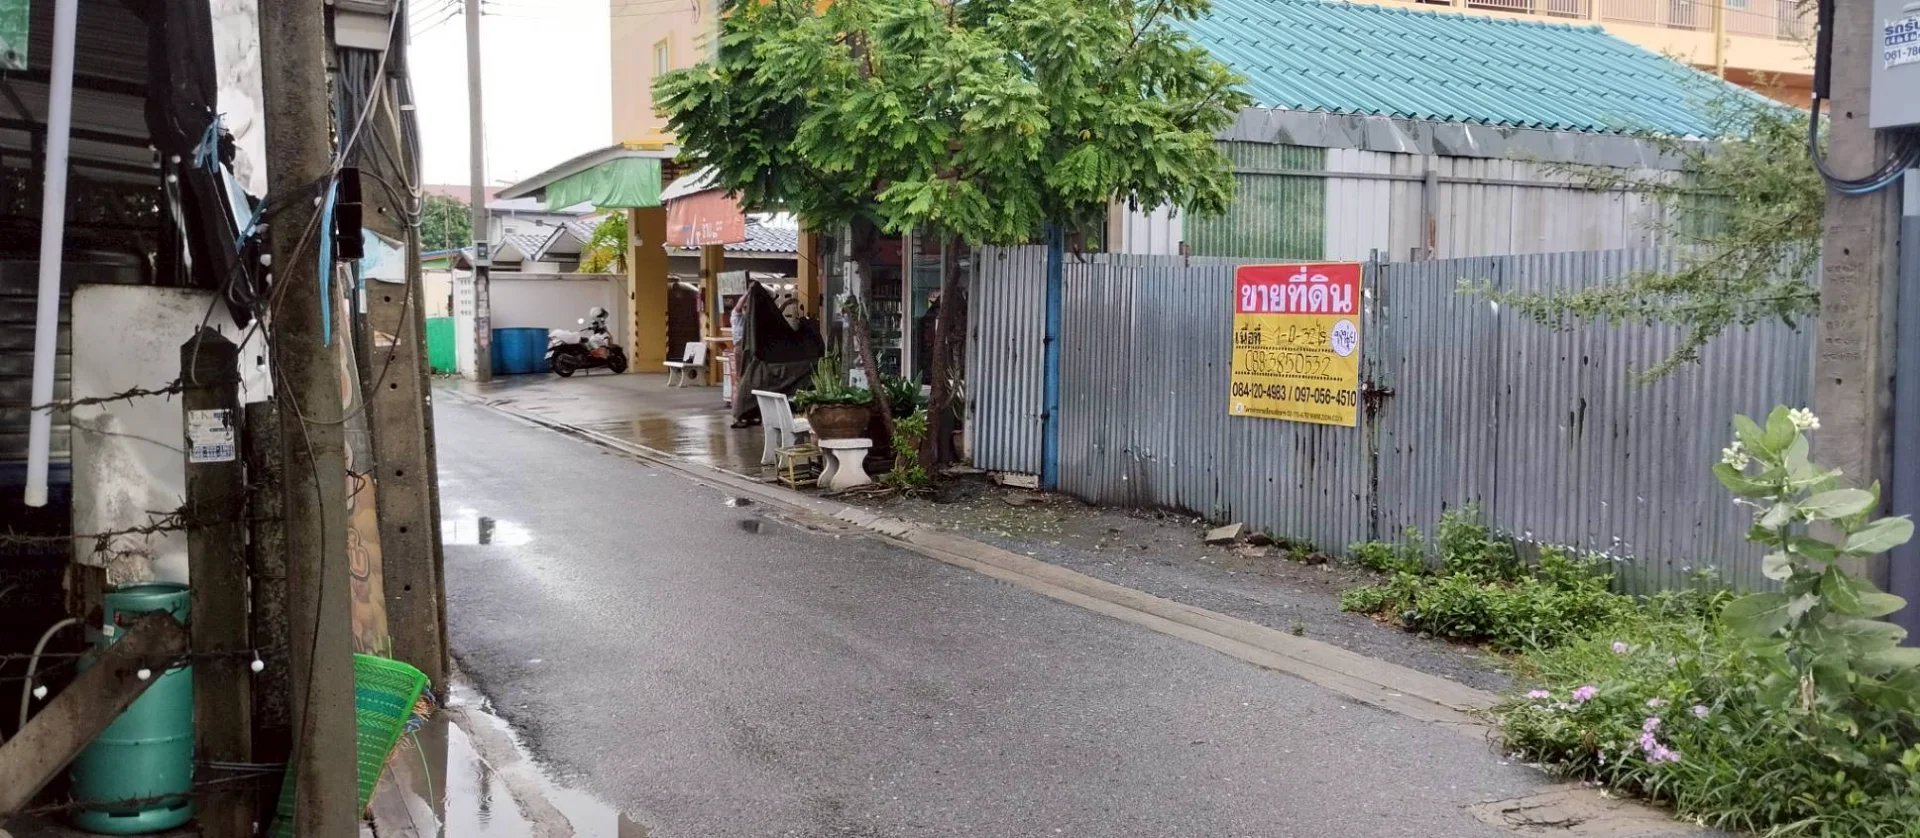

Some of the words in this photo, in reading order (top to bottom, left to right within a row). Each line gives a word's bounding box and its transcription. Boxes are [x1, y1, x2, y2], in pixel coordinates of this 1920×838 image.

[1884, 46, 1920, 61] 061-78
[1241, 266, 1352, 313] ขายที่ดิน
[1235, 322, 1261, 345] เนื้อที่
[1232, 382, 1286, 401] 084-120-4983
[1295, 386, 1356, 407] 097-056-4510
